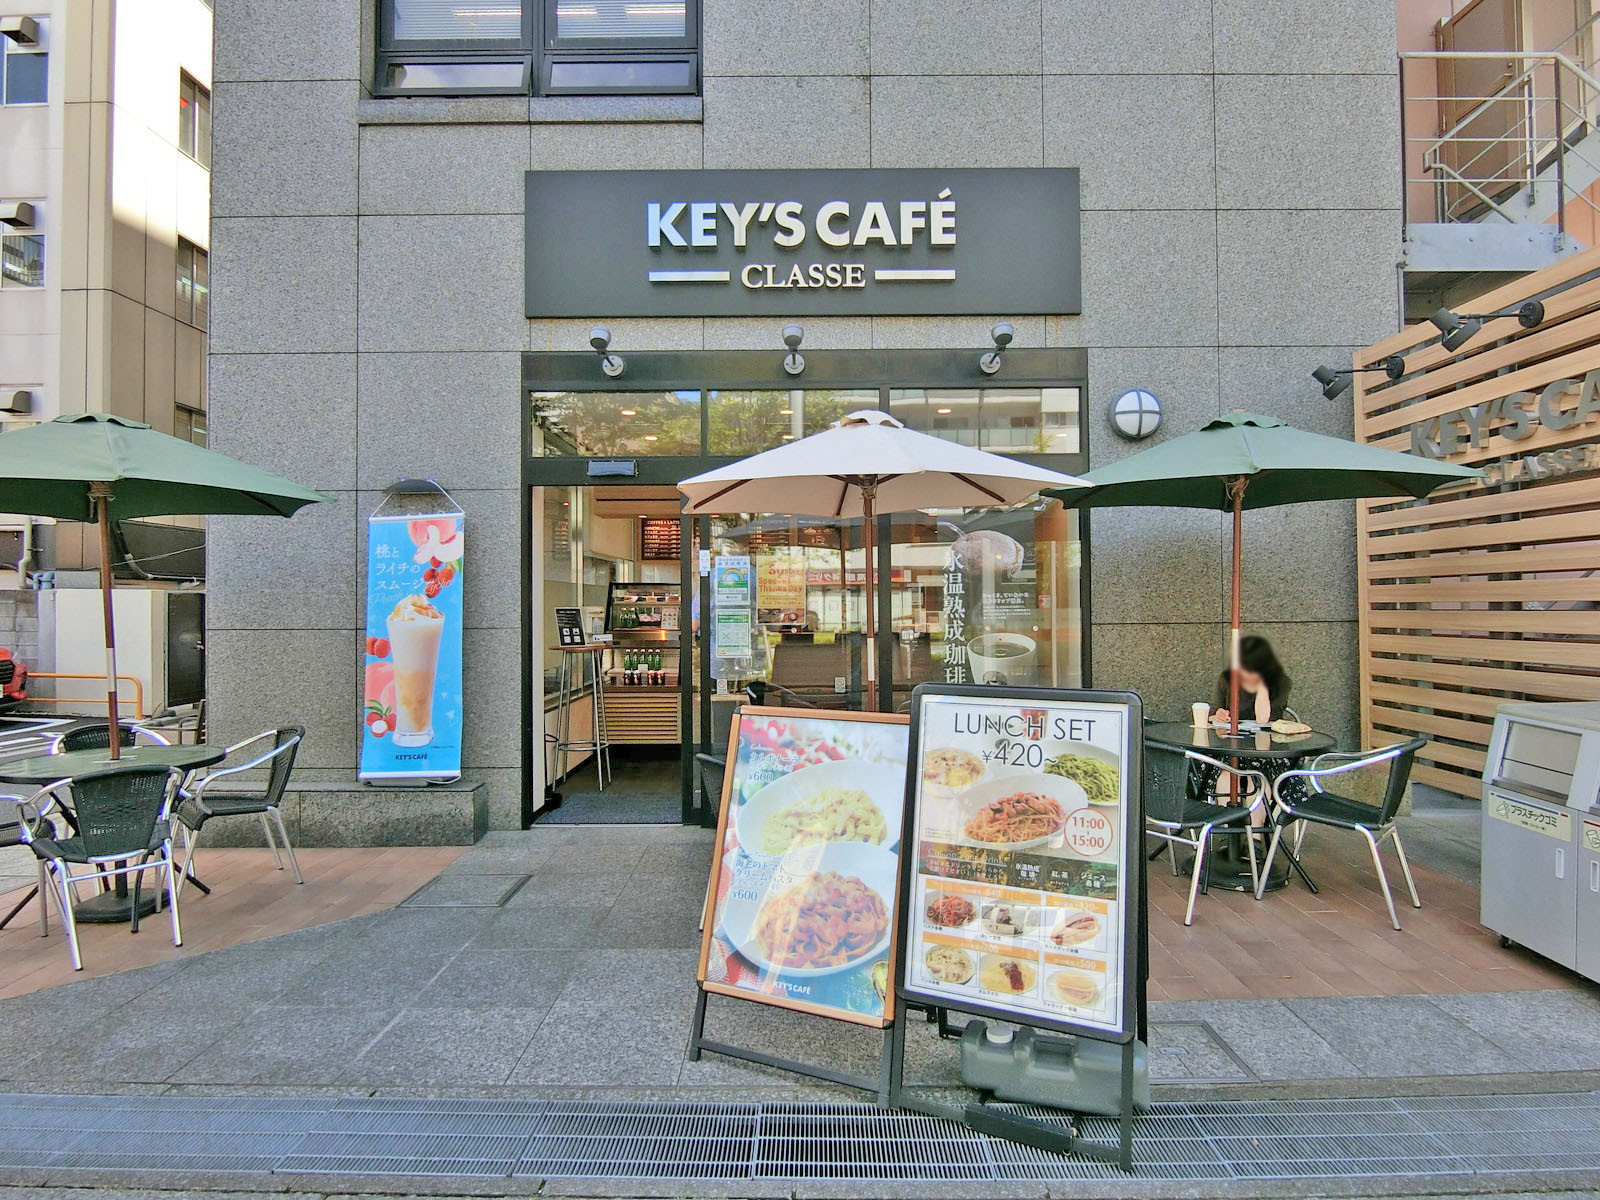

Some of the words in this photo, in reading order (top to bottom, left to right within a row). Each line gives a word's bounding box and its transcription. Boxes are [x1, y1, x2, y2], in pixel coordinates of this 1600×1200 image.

[648, 201, 806, 247] KEY'S
[815, 187, 957, 246] CAFÉ
[741, 263, 866, 288] CLASSE
[375, 543, 400, 559] 桃と
[376, 561, 420, 576] ライチの
[954, 712, 1043, 738] LUNCH
[1053, 718, 1097, 742] SET
[1072, 816, 1105, 830] 11:00
[1511, 804, 1558, 828] プラスチックゴミ
[1072, 834, 1105, 848] 15:00
